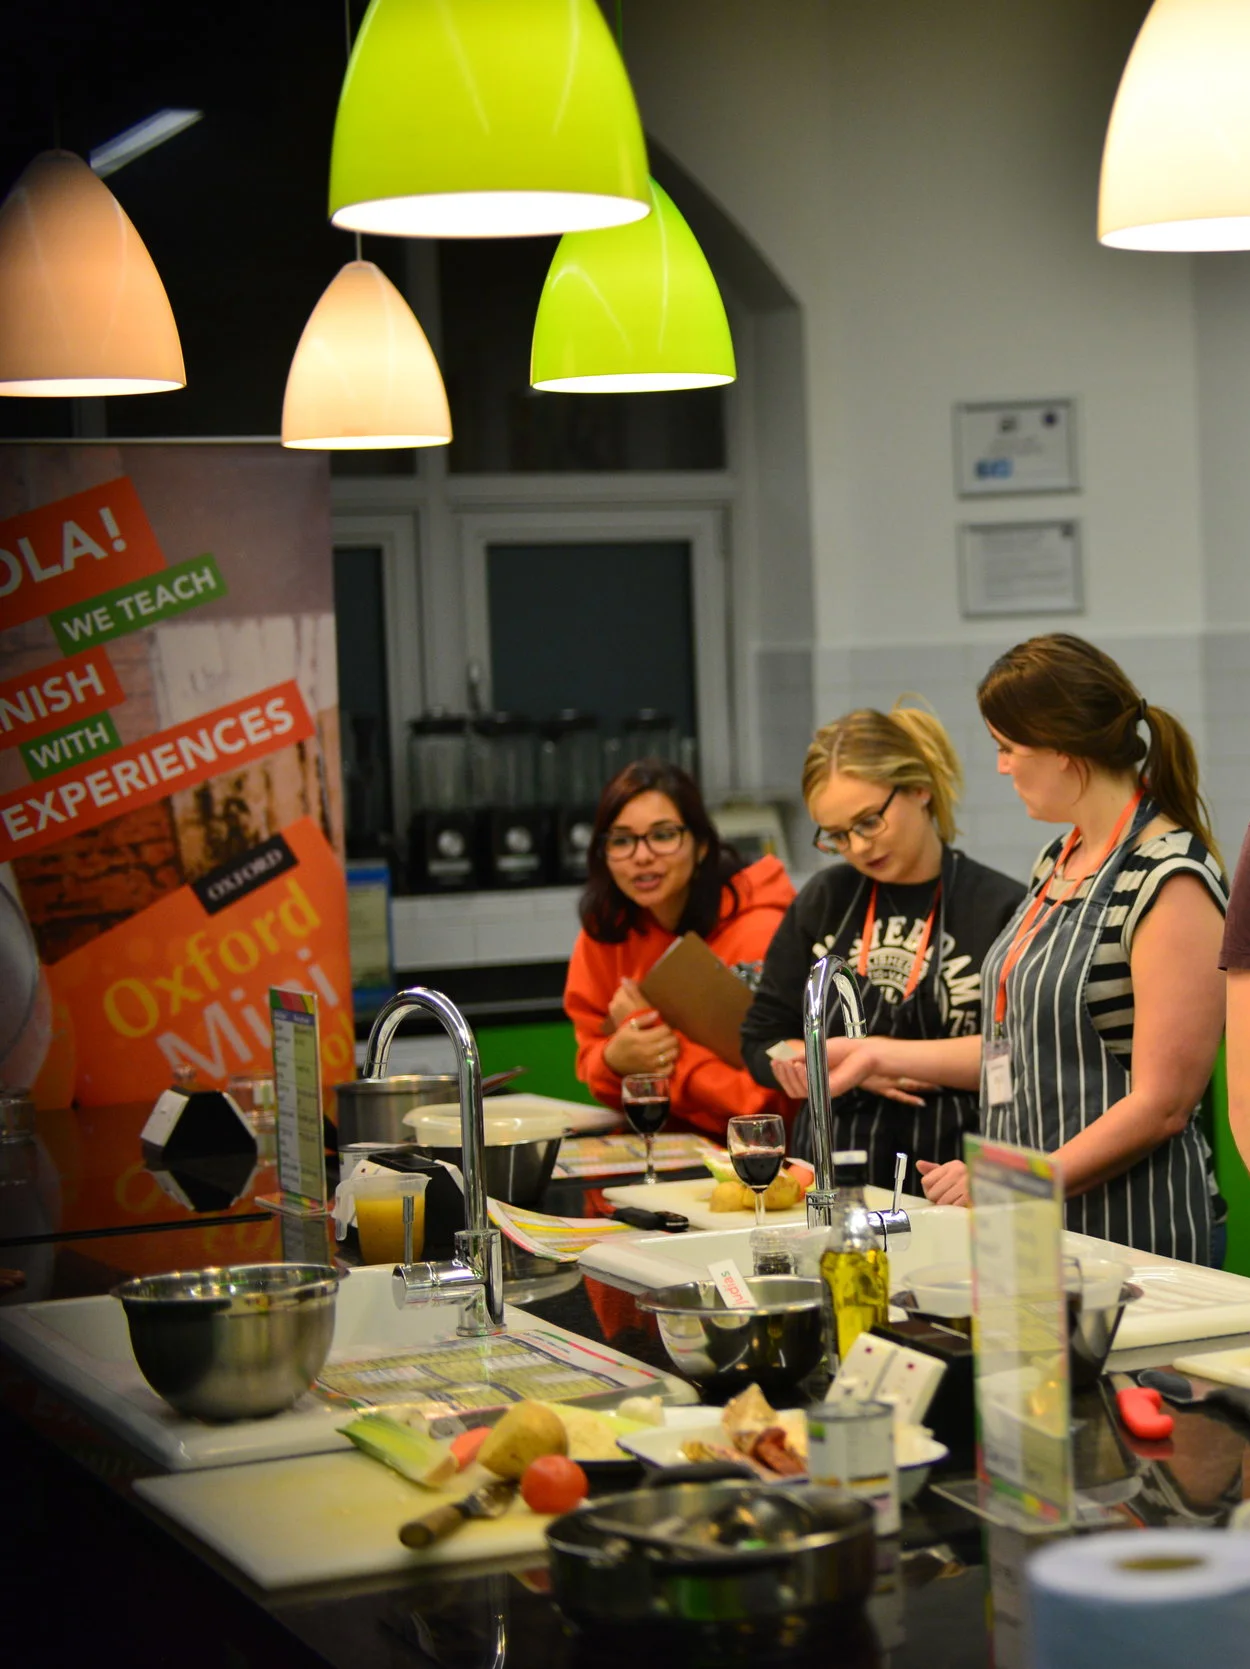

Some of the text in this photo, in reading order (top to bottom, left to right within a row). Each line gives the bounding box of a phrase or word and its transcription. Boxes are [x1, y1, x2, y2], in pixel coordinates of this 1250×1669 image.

[62, 566, 217, 642] WE TEACH
[0, 663, 105, 734] NISH
[1, 697, 295, 841] EXPERIENCES
[30, 722, 111, 770] WITH
[207, 848, 284, 901] OXFORD
[103, 877, 321, 1038] Oxford
[156, 946, 339, 1079] Mii
